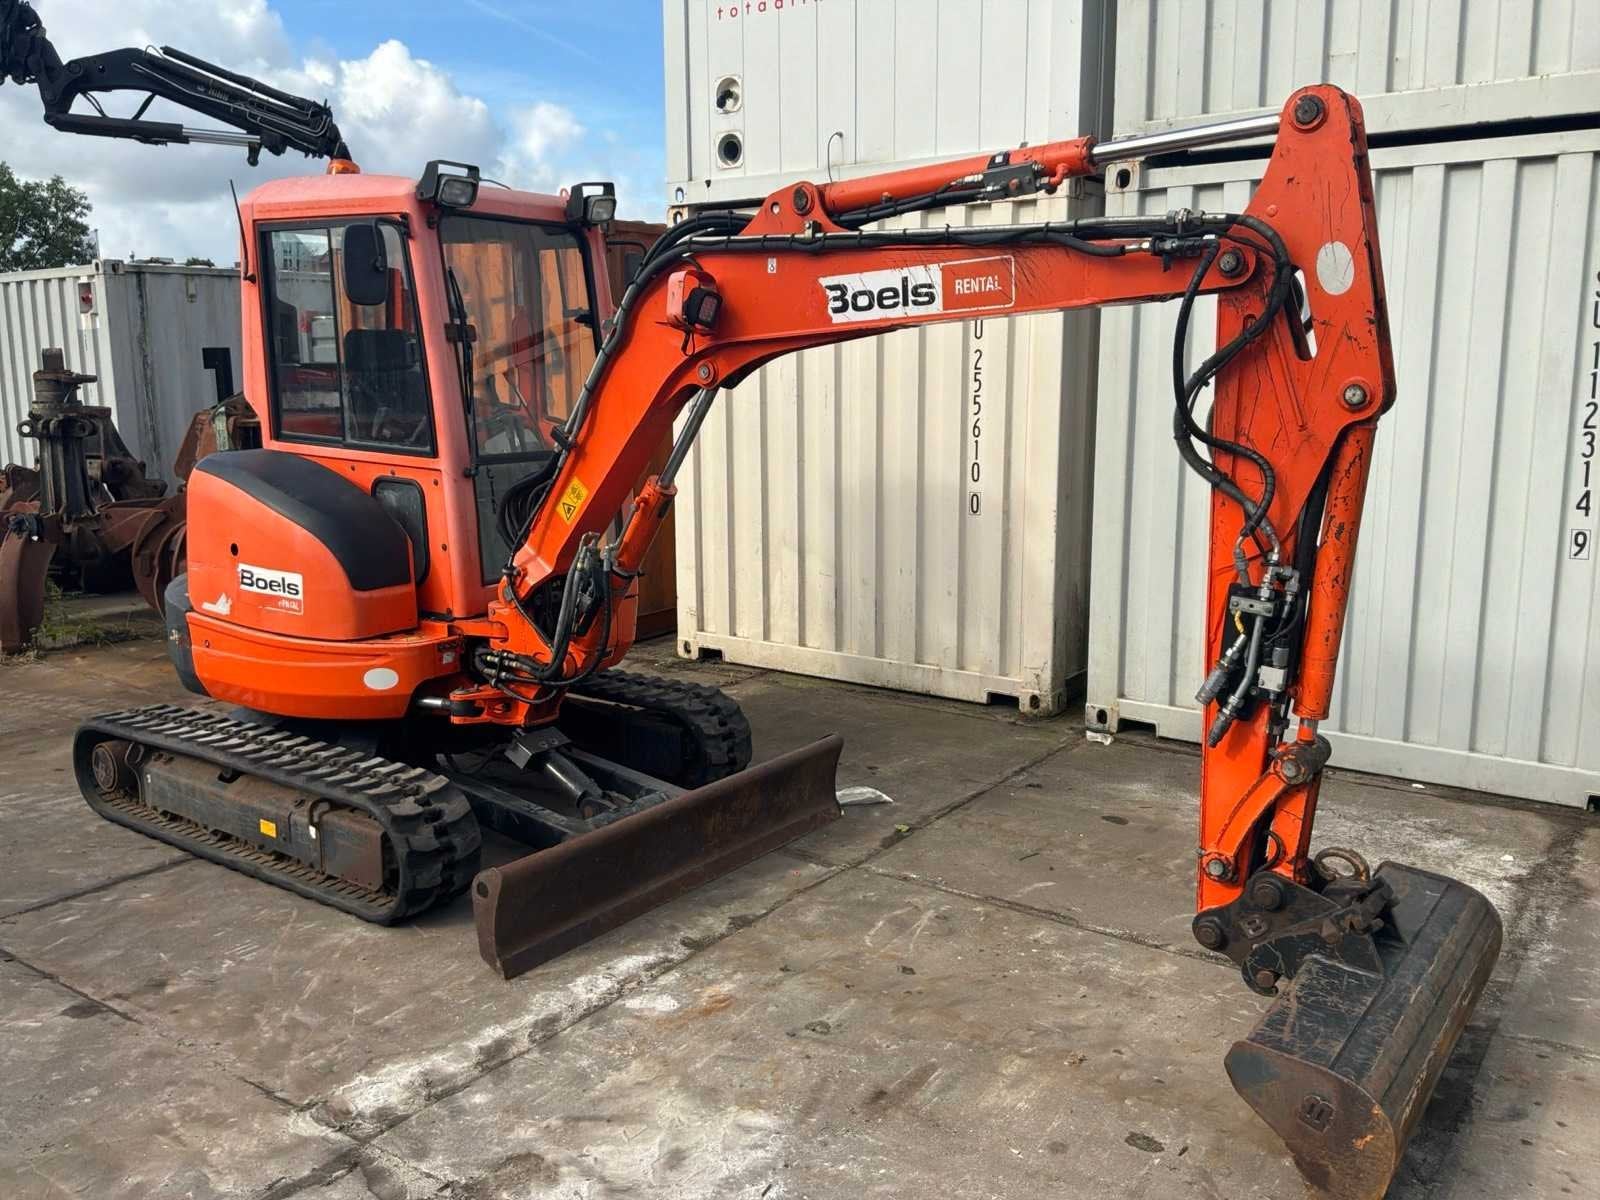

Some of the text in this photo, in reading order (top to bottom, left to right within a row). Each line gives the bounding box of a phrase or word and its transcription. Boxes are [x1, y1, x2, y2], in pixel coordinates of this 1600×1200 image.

[825, 275, 1002, 314] Boels RENTAL
[971, 349, 983, 482] 255610
[1572, 531, 1588, 557] 9
[241, 569, 299, 595] Boels
